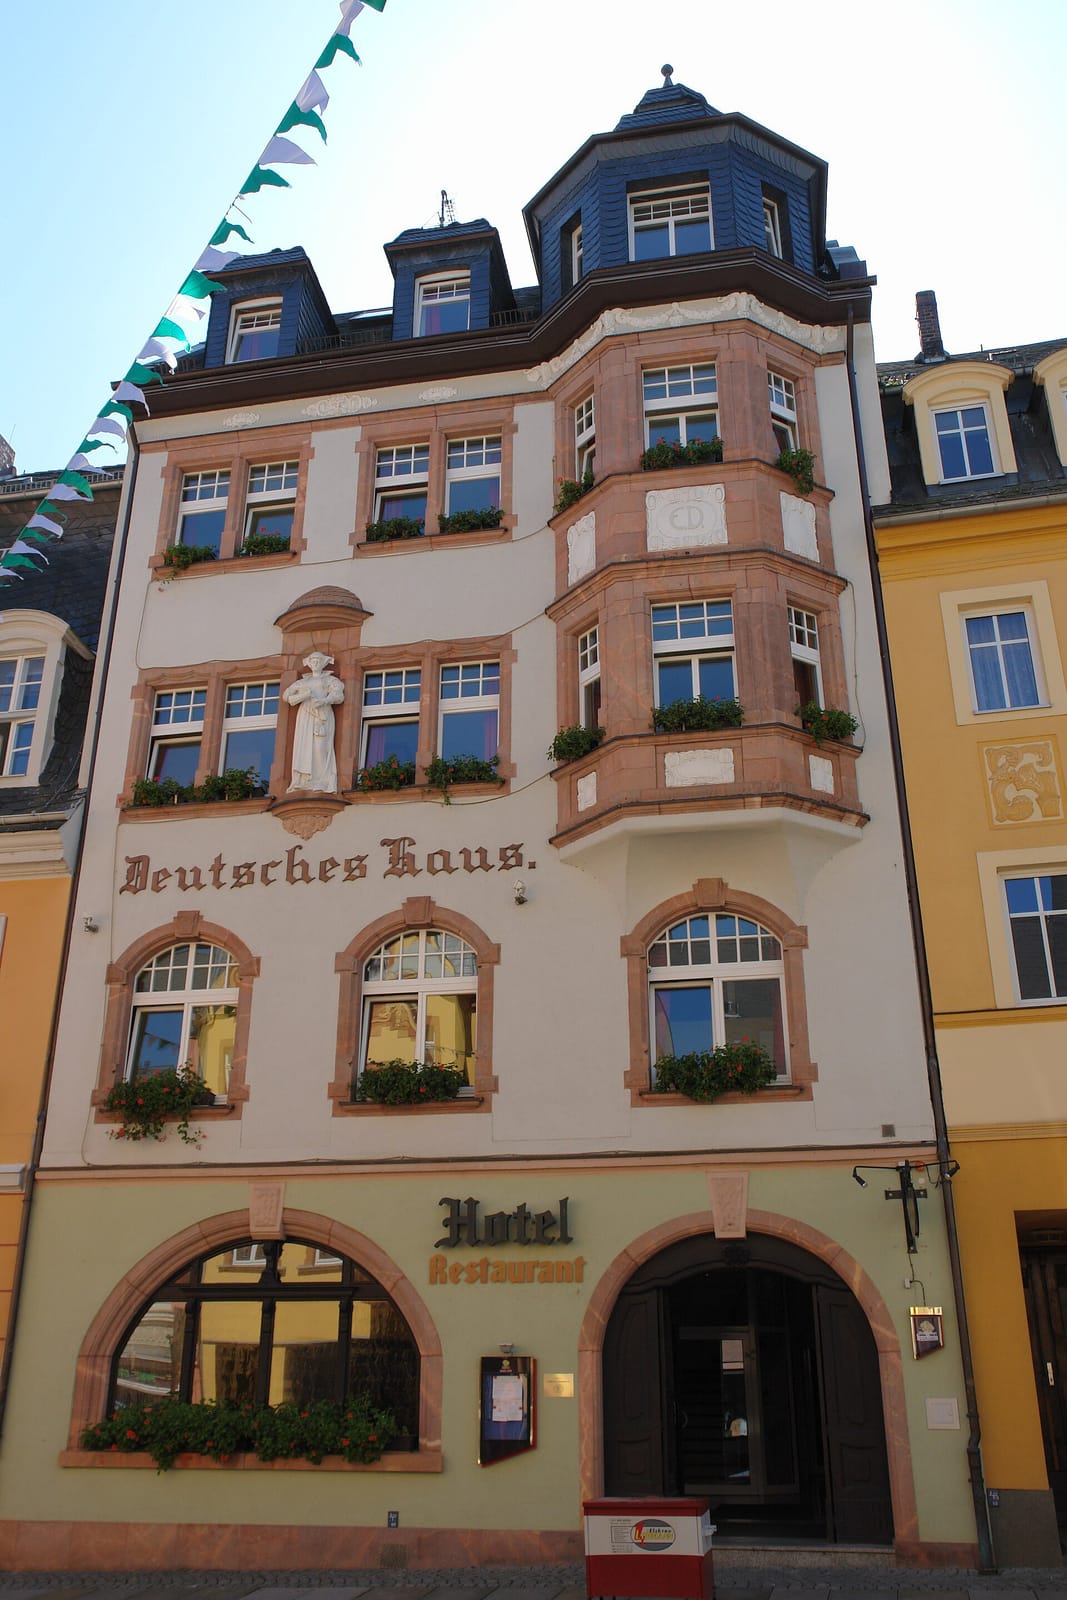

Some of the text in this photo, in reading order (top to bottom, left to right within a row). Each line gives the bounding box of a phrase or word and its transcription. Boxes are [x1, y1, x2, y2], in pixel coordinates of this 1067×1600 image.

[119, 844, 369, 895] Deutsches
[433, 1196, 574, 1248] Hotel
[428, 1253, 587, 1285] Restaurant
